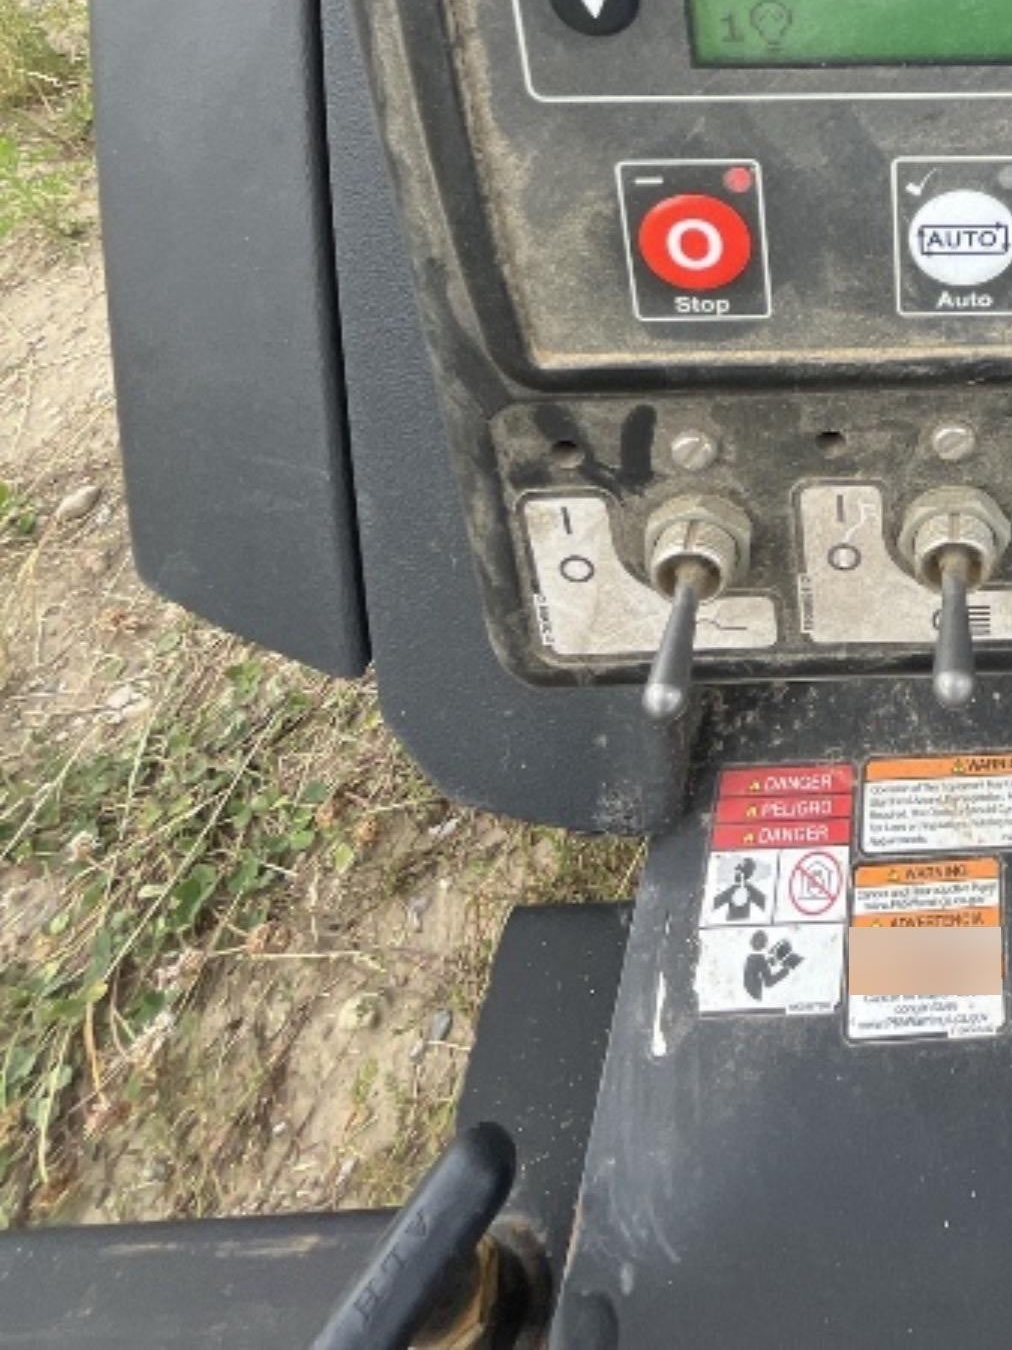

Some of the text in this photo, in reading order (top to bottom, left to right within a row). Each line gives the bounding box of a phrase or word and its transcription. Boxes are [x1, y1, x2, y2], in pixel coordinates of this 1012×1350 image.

[926, 230, 998, 248] AUTO
[674, 295, 730, 317] Stop
[935, 290, 993, 308] Auto
[763, 773, 833, 792] DANGER
[761, 799, 833, 818] PELIGRO
[757, 824, 829, 844] DANGER
